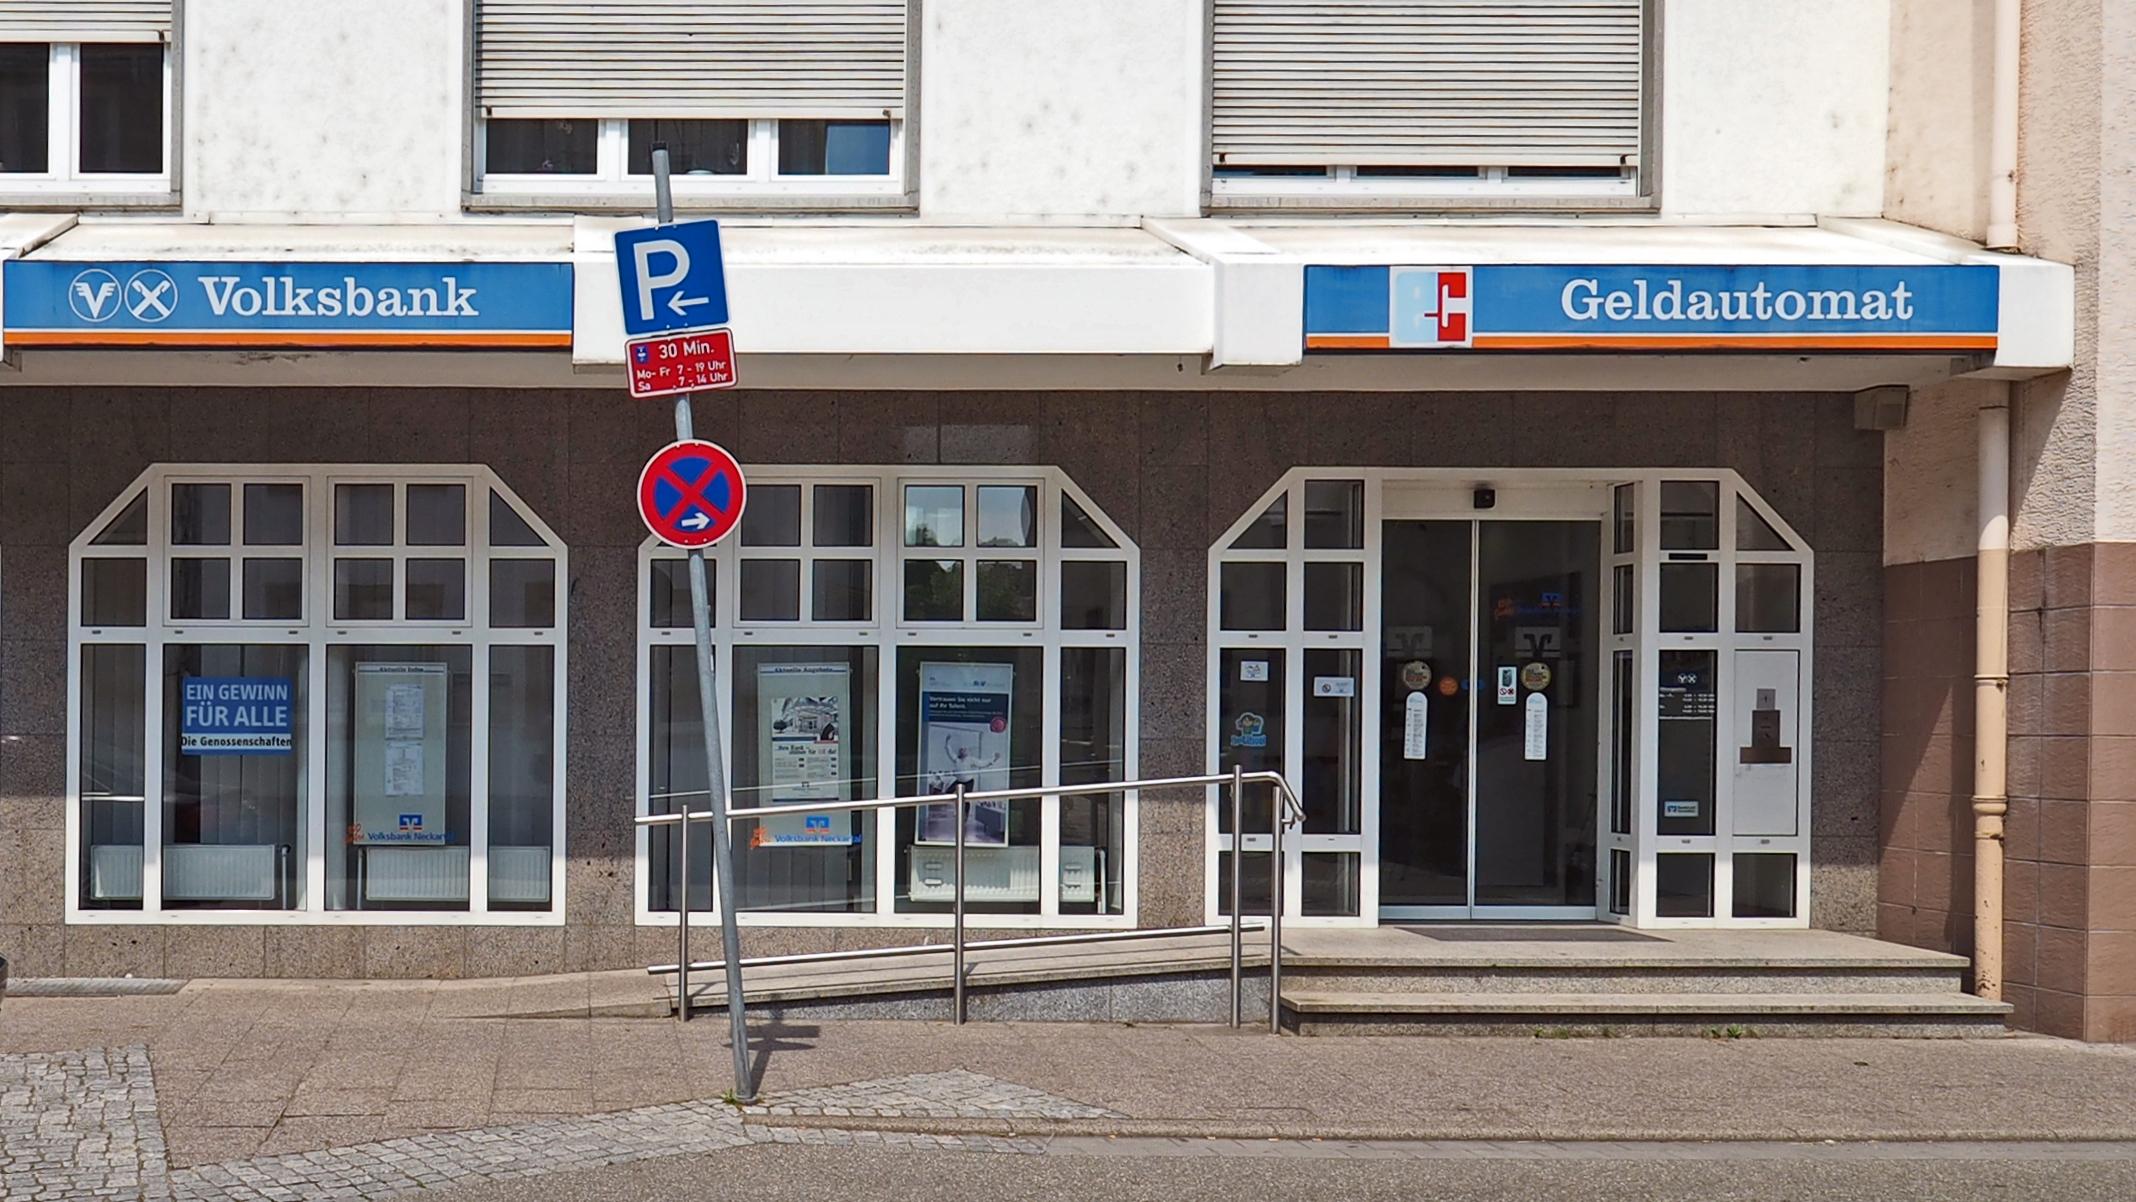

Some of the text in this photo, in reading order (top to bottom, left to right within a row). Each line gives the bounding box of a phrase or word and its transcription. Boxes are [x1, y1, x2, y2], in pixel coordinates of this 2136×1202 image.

[633, 239, 691, 321] P
[197, 275, 480, 317] Volksbank
[1560, 278, 1915, 322] Geldautomat
[658, 340, 715, 359] 30 Min.
[659, 367, 671, 378] Fr
[676, 364, 684, 375] 7
[694, 362, 705, 374] 19
[707, 360, 727, 371] Uhr
[638, 381, 652, 392] Sa
[678, 376, 685, 387] 7
[695, 373, 707, 385] 14
[709, 371, 729, 382] Uhr
[186, 684, 288, 700] EIN GEWINN
[186, 700, 288, 727] FÜR ALLE
[181, 735, 292, 747] Die Genossenschaften
[367, 831, 411, 841] Volksbank
